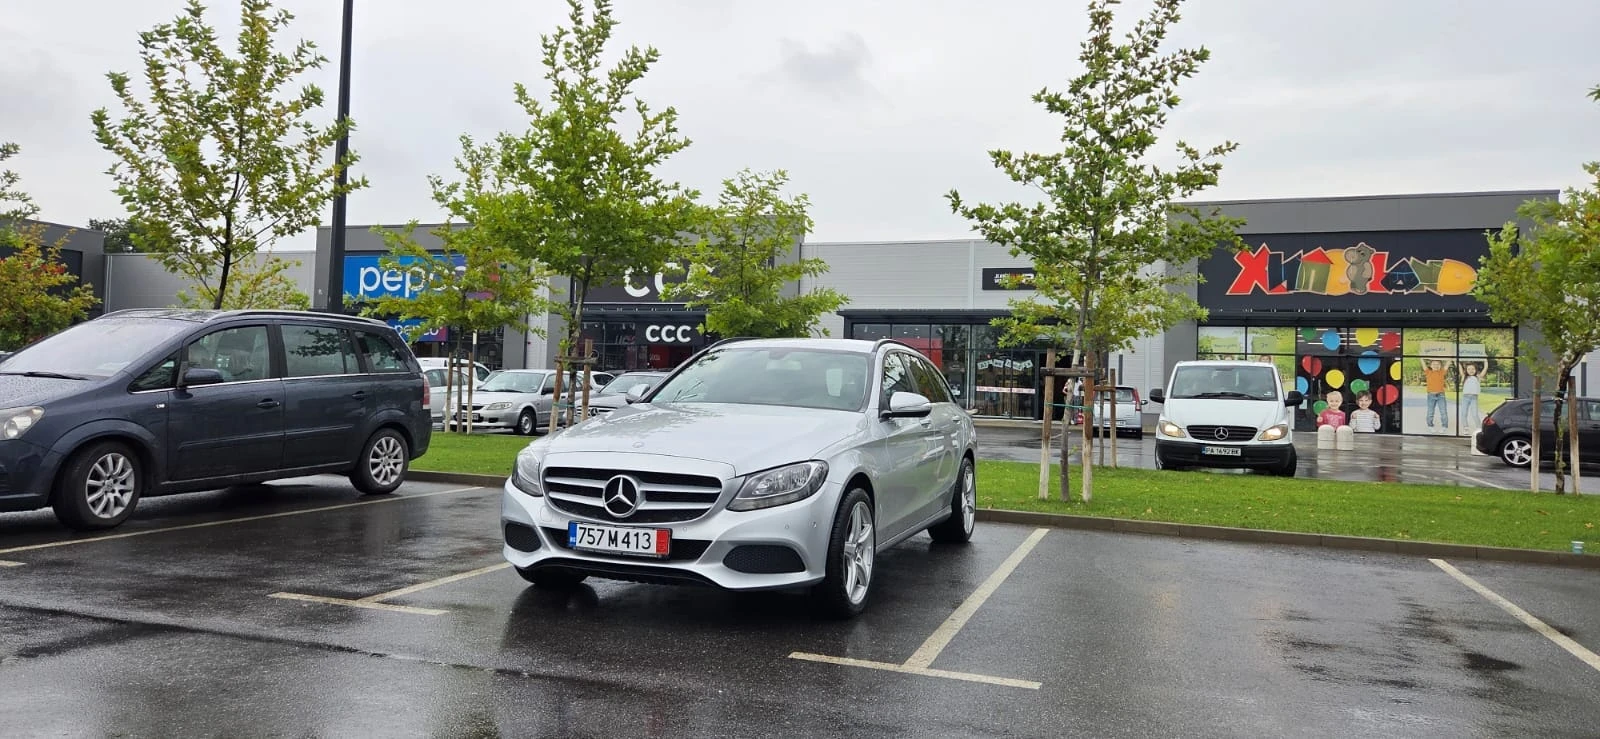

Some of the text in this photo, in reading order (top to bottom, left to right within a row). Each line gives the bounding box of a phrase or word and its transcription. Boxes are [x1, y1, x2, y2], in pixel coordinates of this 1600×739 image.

[645, 324, 692, 343] CCC
[578, 527, 651, 550] 757 M 413
